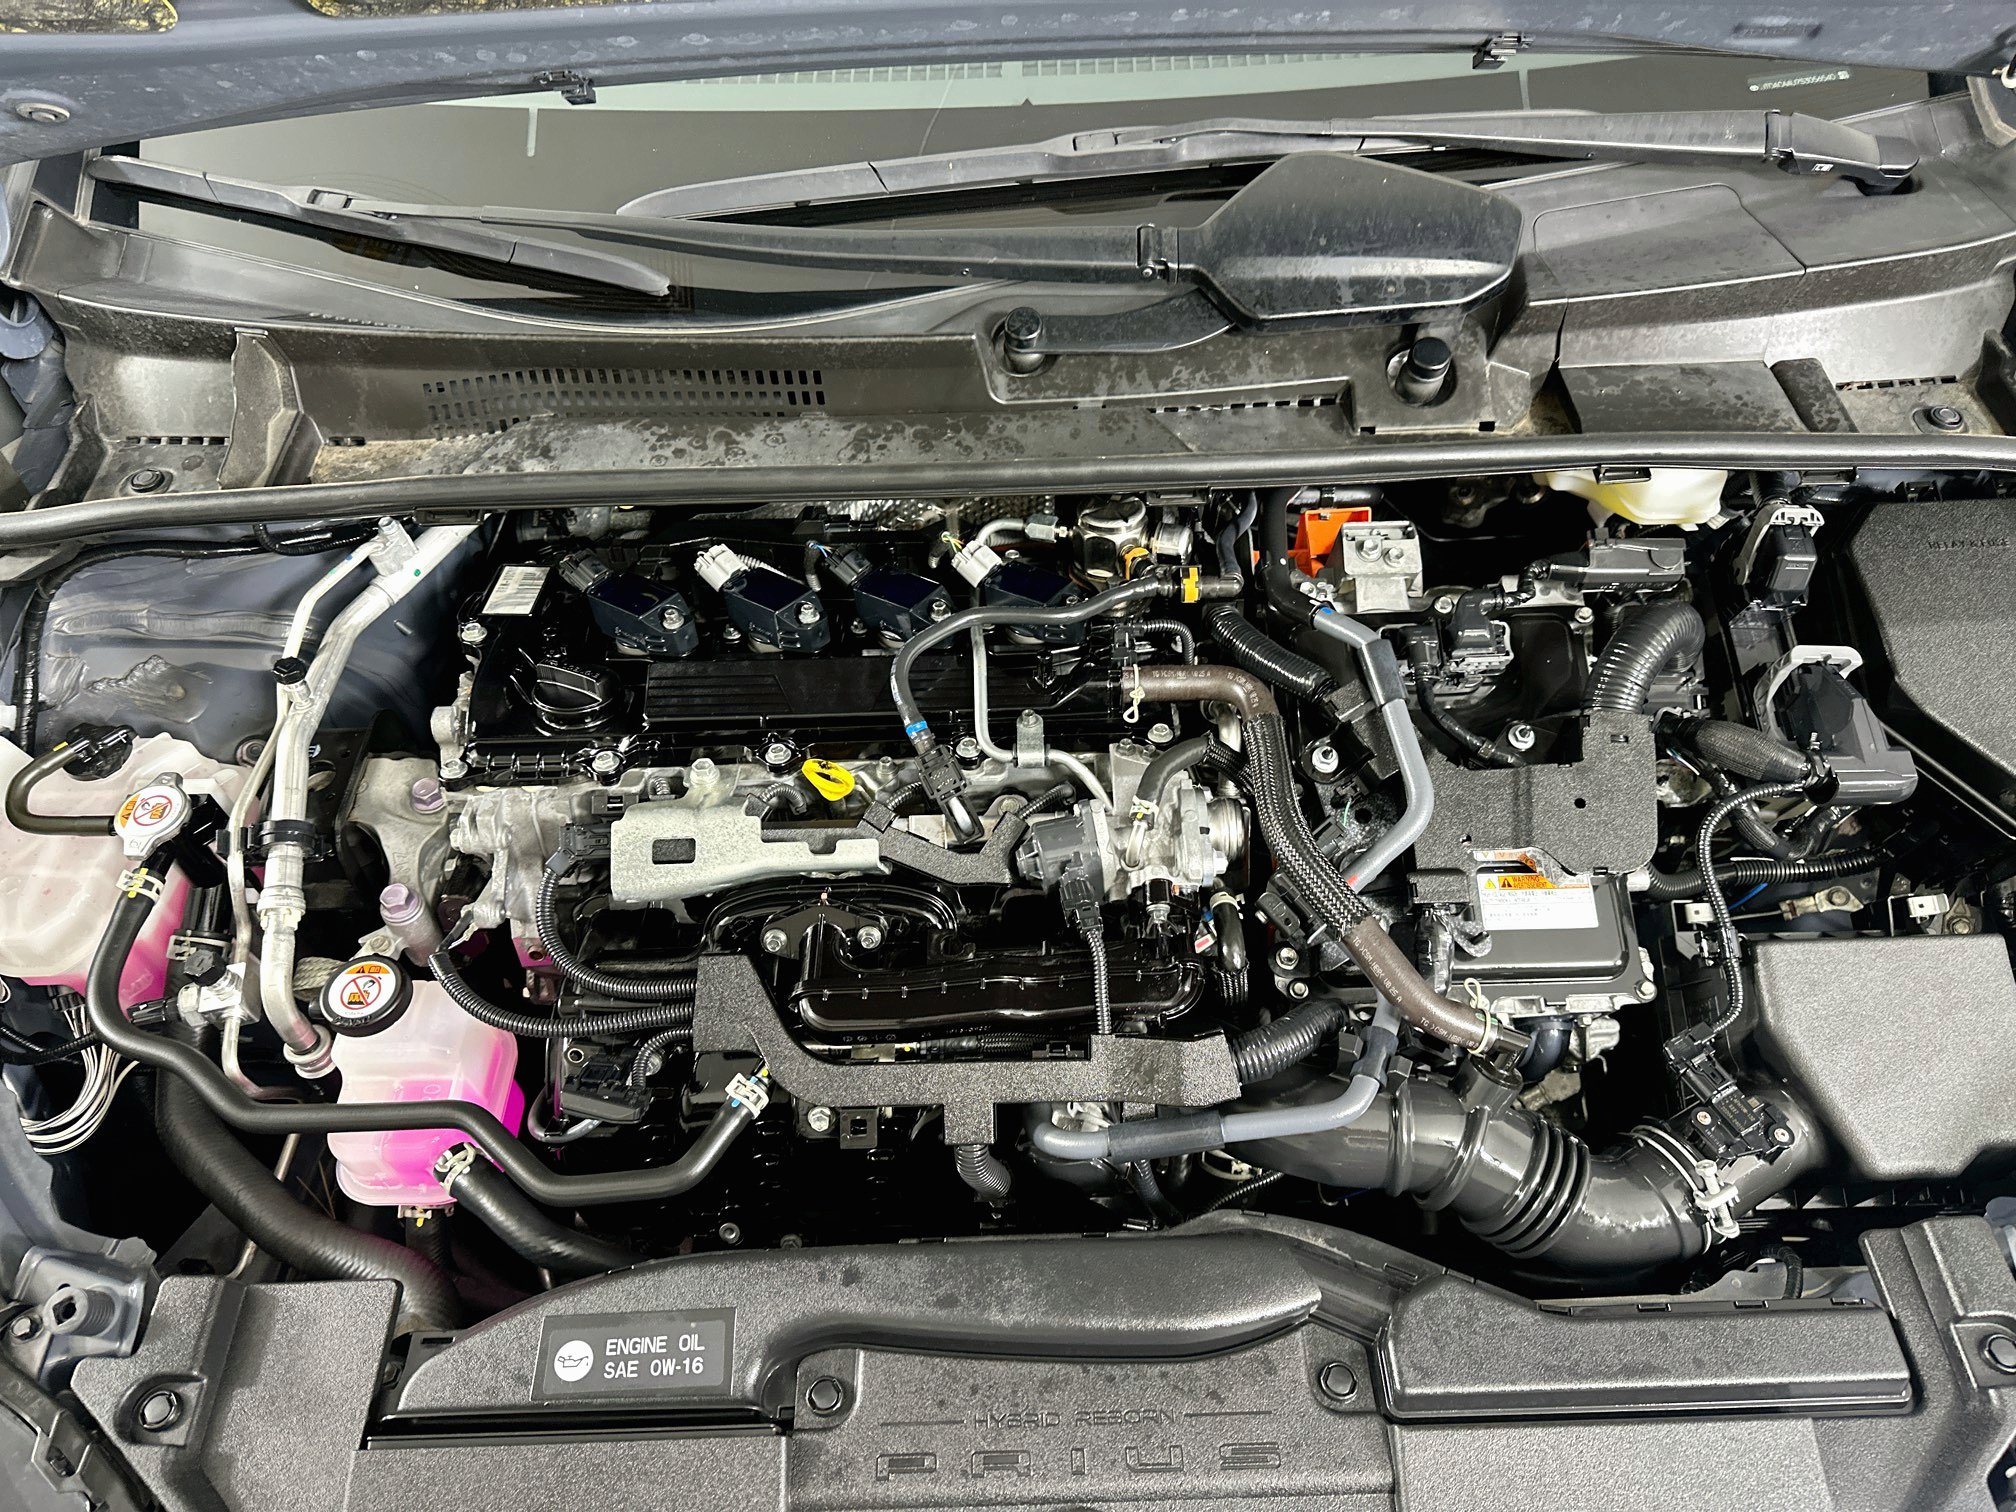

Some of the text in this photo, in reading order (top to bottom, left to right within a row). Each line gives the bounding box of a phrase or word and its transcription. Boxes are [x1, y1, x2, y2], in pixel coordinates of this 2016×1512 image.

[605, 1333, 706, 1356] ENGINE OIL
[603, 1357, 704, 1379] SAE 0W-16
[974, 1408, 1176, 1429] HYBRID REBORN
[875, 1442, 1281, 1482] PRIUS
